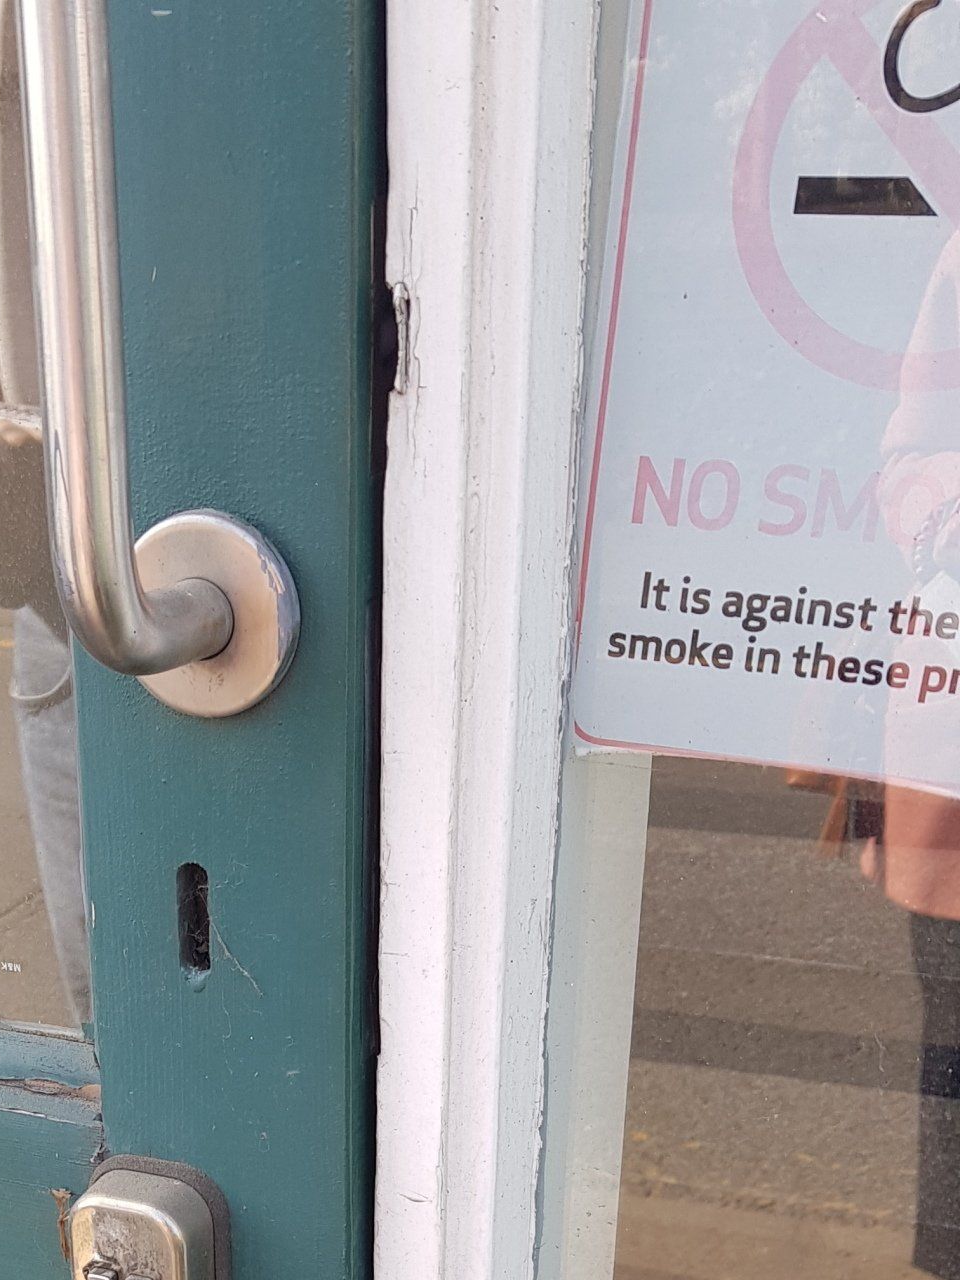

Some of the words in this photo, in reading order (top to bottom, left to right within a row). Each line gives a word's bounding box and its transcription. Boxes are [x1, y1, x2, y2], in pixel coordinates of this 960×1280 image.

[631, 455, 741, 532] NO
[640, 571, 670, 612] It
[679, 576, 711, 616] is
[721, 586, 878, 633] against
[888, 596, 960, 640] the
[607, 629, 734, 670] smoke
[744, 635, 781, 675] in
[792, 641, 911, 689] these
